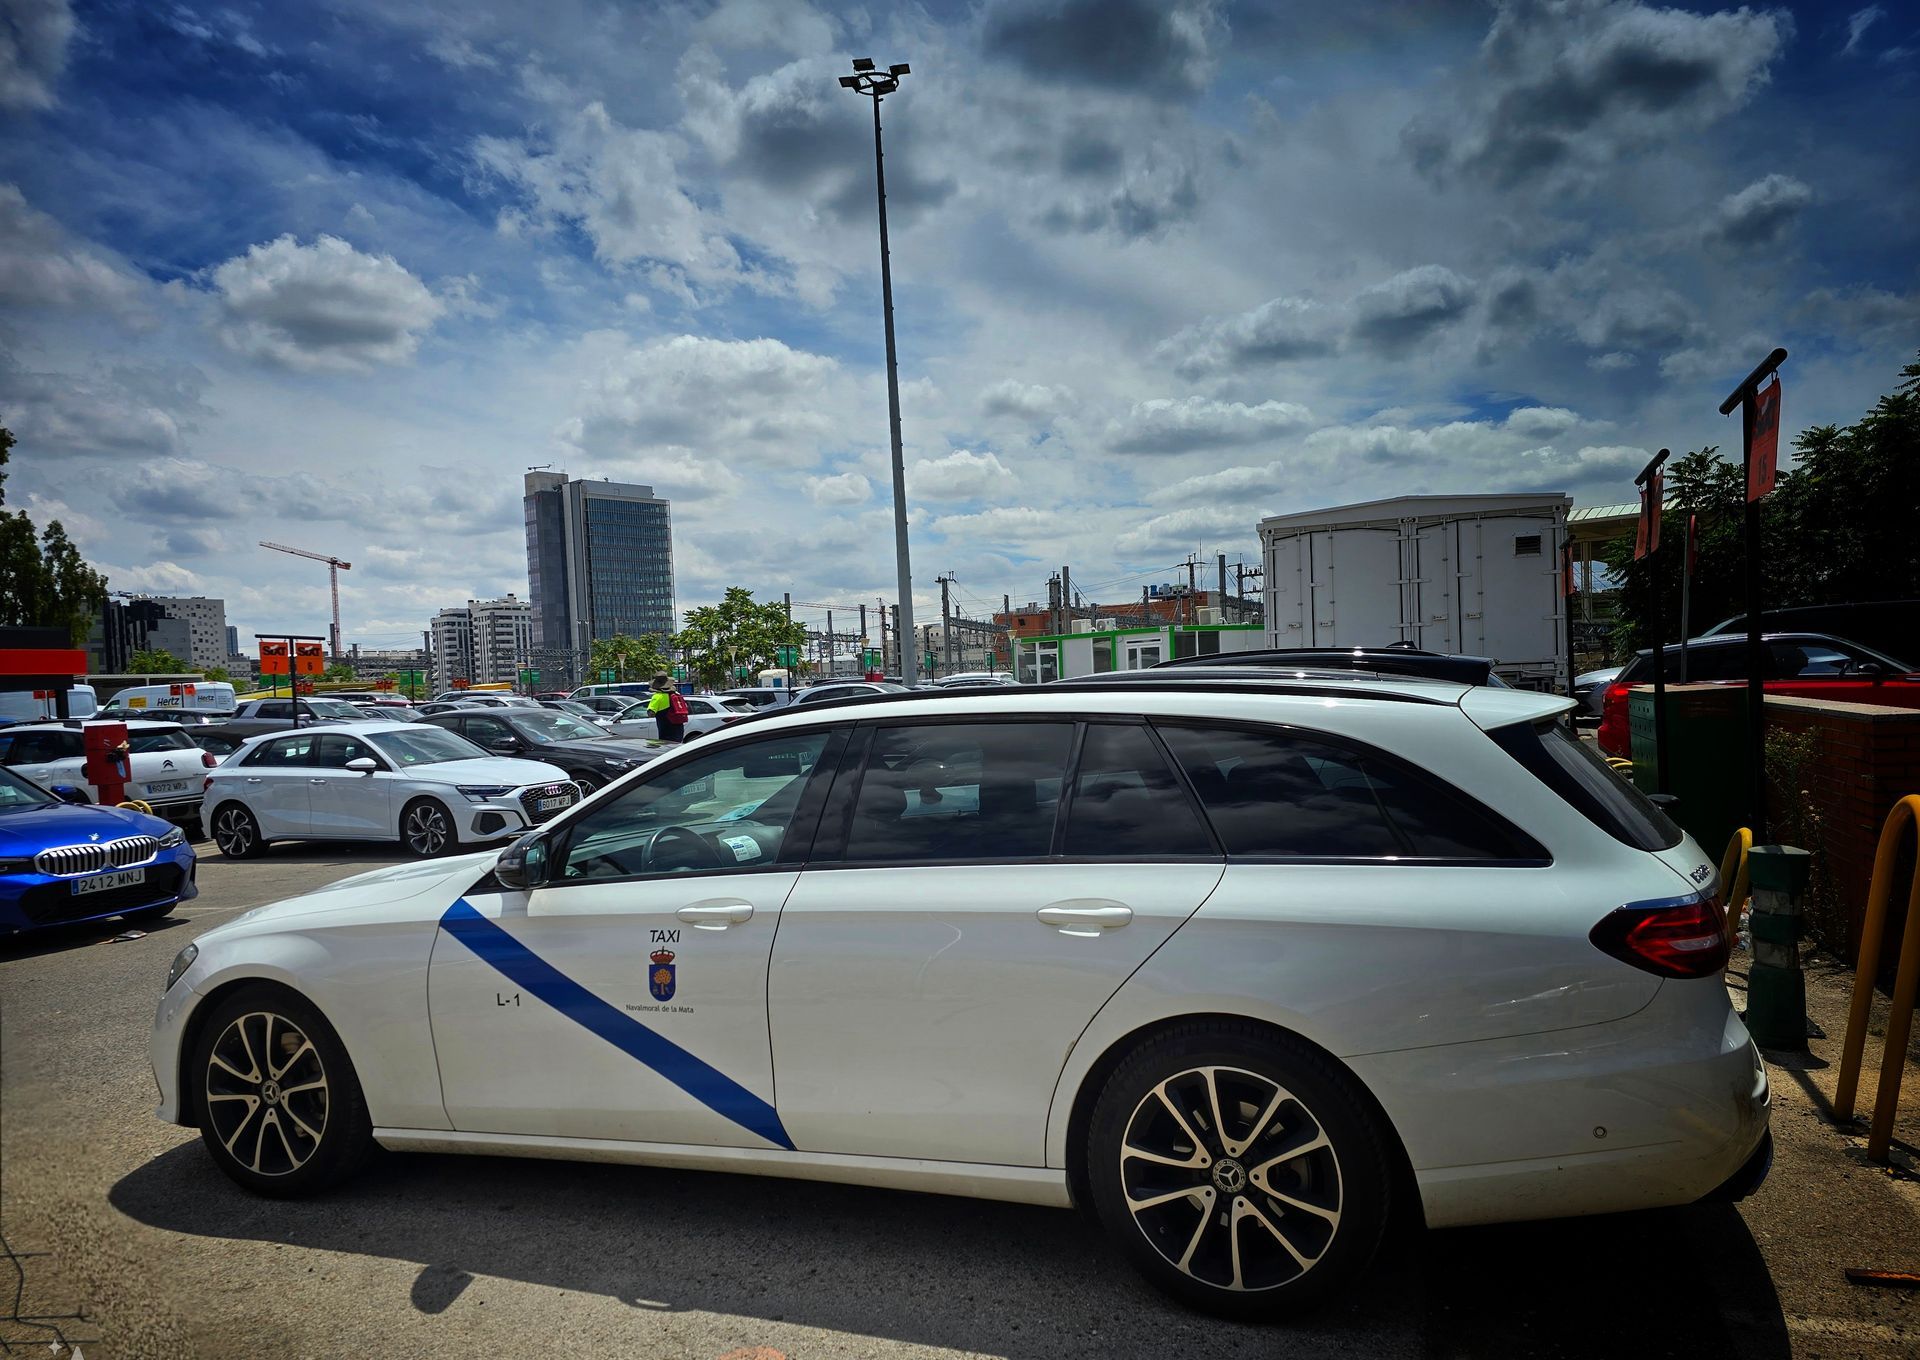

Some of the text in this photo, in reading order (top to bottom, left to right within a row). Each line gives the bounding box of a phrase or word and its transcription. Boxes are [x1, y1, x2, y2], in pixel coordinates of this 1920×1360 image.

[272, 661, 278, 671] 7
[156, 697, 180, 707] Hertz
[197, 695, 215, 703] Hertz
[80, 870, 142, 892] 2412 MNJ
[649, 929, 681, 943] TAXI
[625, 1003, 660, 1012] Navalmoral
[661, 1005, 669, 1013] de
[678, 1006, 694, 1014] Mata
